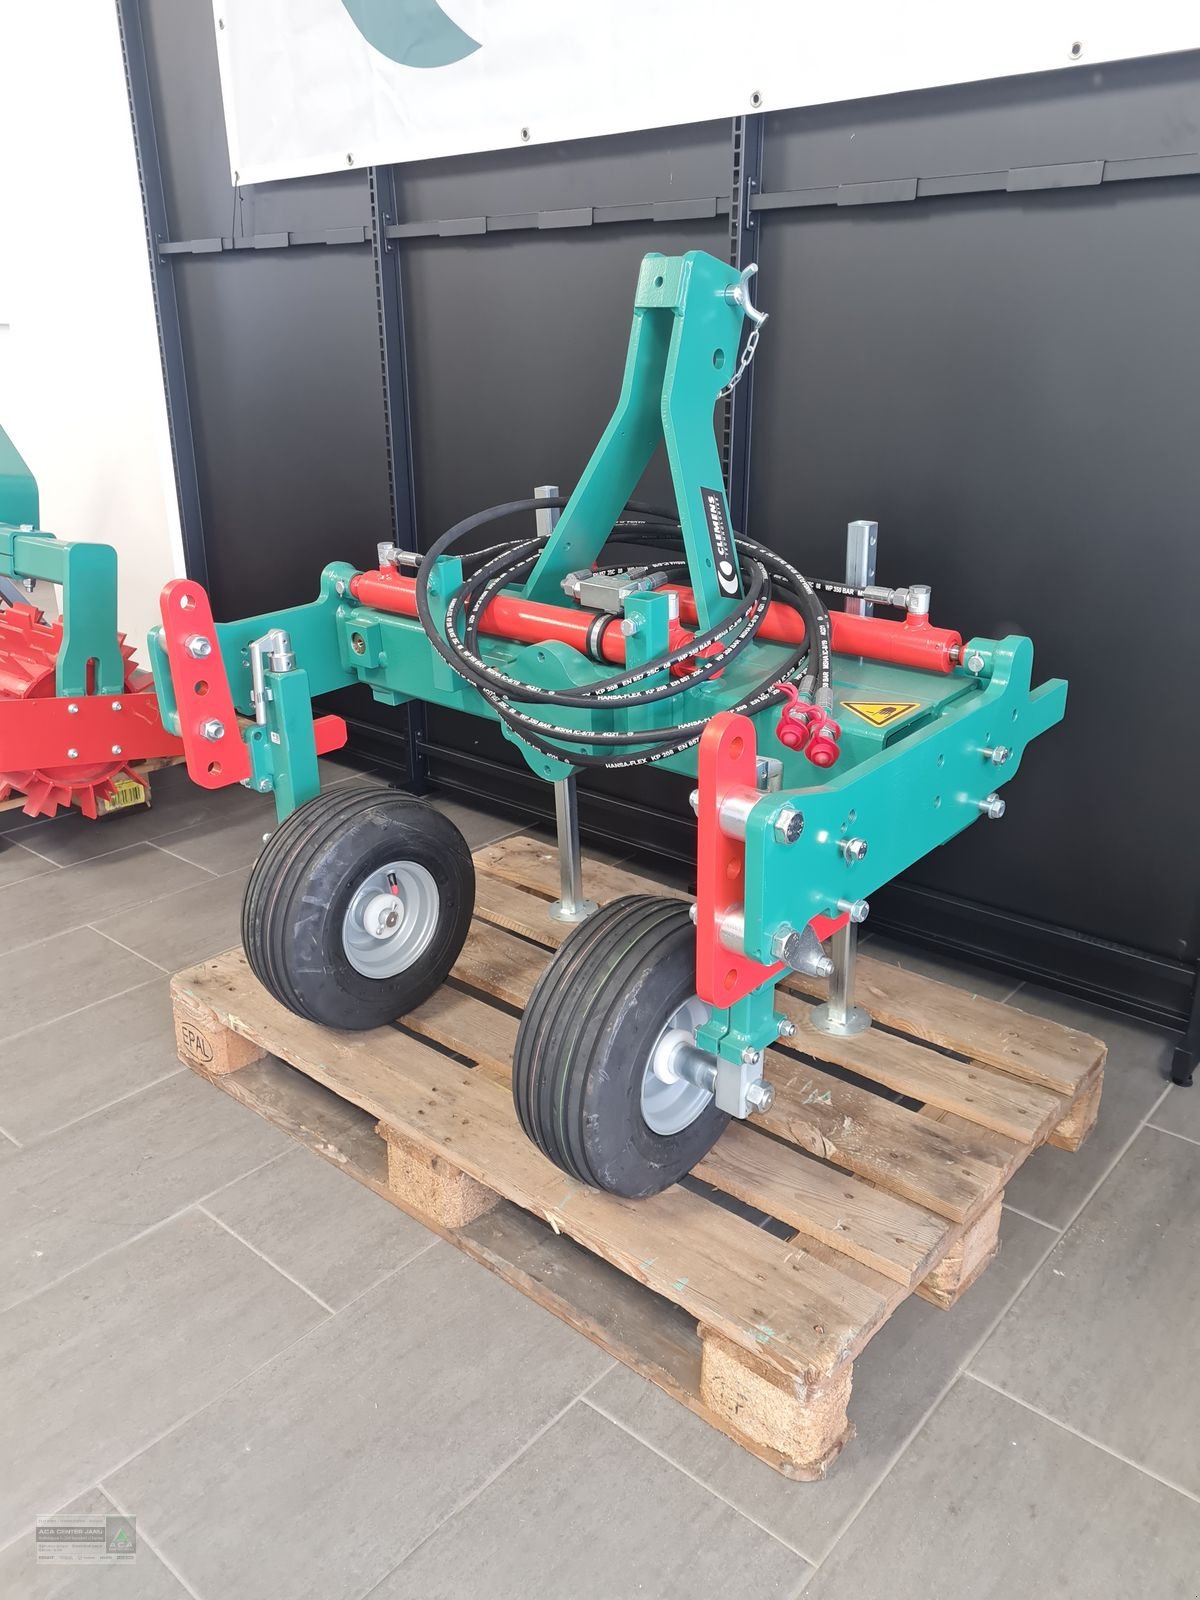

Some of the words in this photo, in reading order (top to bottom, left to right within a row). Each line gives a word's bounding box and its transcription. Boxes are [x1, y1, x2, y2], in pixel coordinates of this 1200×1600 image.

[708, 495, 724, 556] CLEMENS
[594, 688, 606, 696] KP
[606, 684, 619, 692] 208
[633, 673, 644, 682] 857
[647, 667, 660, 677] 2SC
[663, 661, 672, 669] 08
[677, 654, 689, 662] WP
[699, 640, 712, 651] BAR
[597, 692, 642, 700] HANSA-FLEX
[554, 726, 573, 735] MSHA
[605, 757, 648, 769] HANSA-FLEX
[650, 754, 661, 762] KP
[661, 749, 674, 758] 208
[677, 743, 689, 751] EN
[688, 737, 700, 746] 857
[182, 1026, 209, 1058] EPAL
